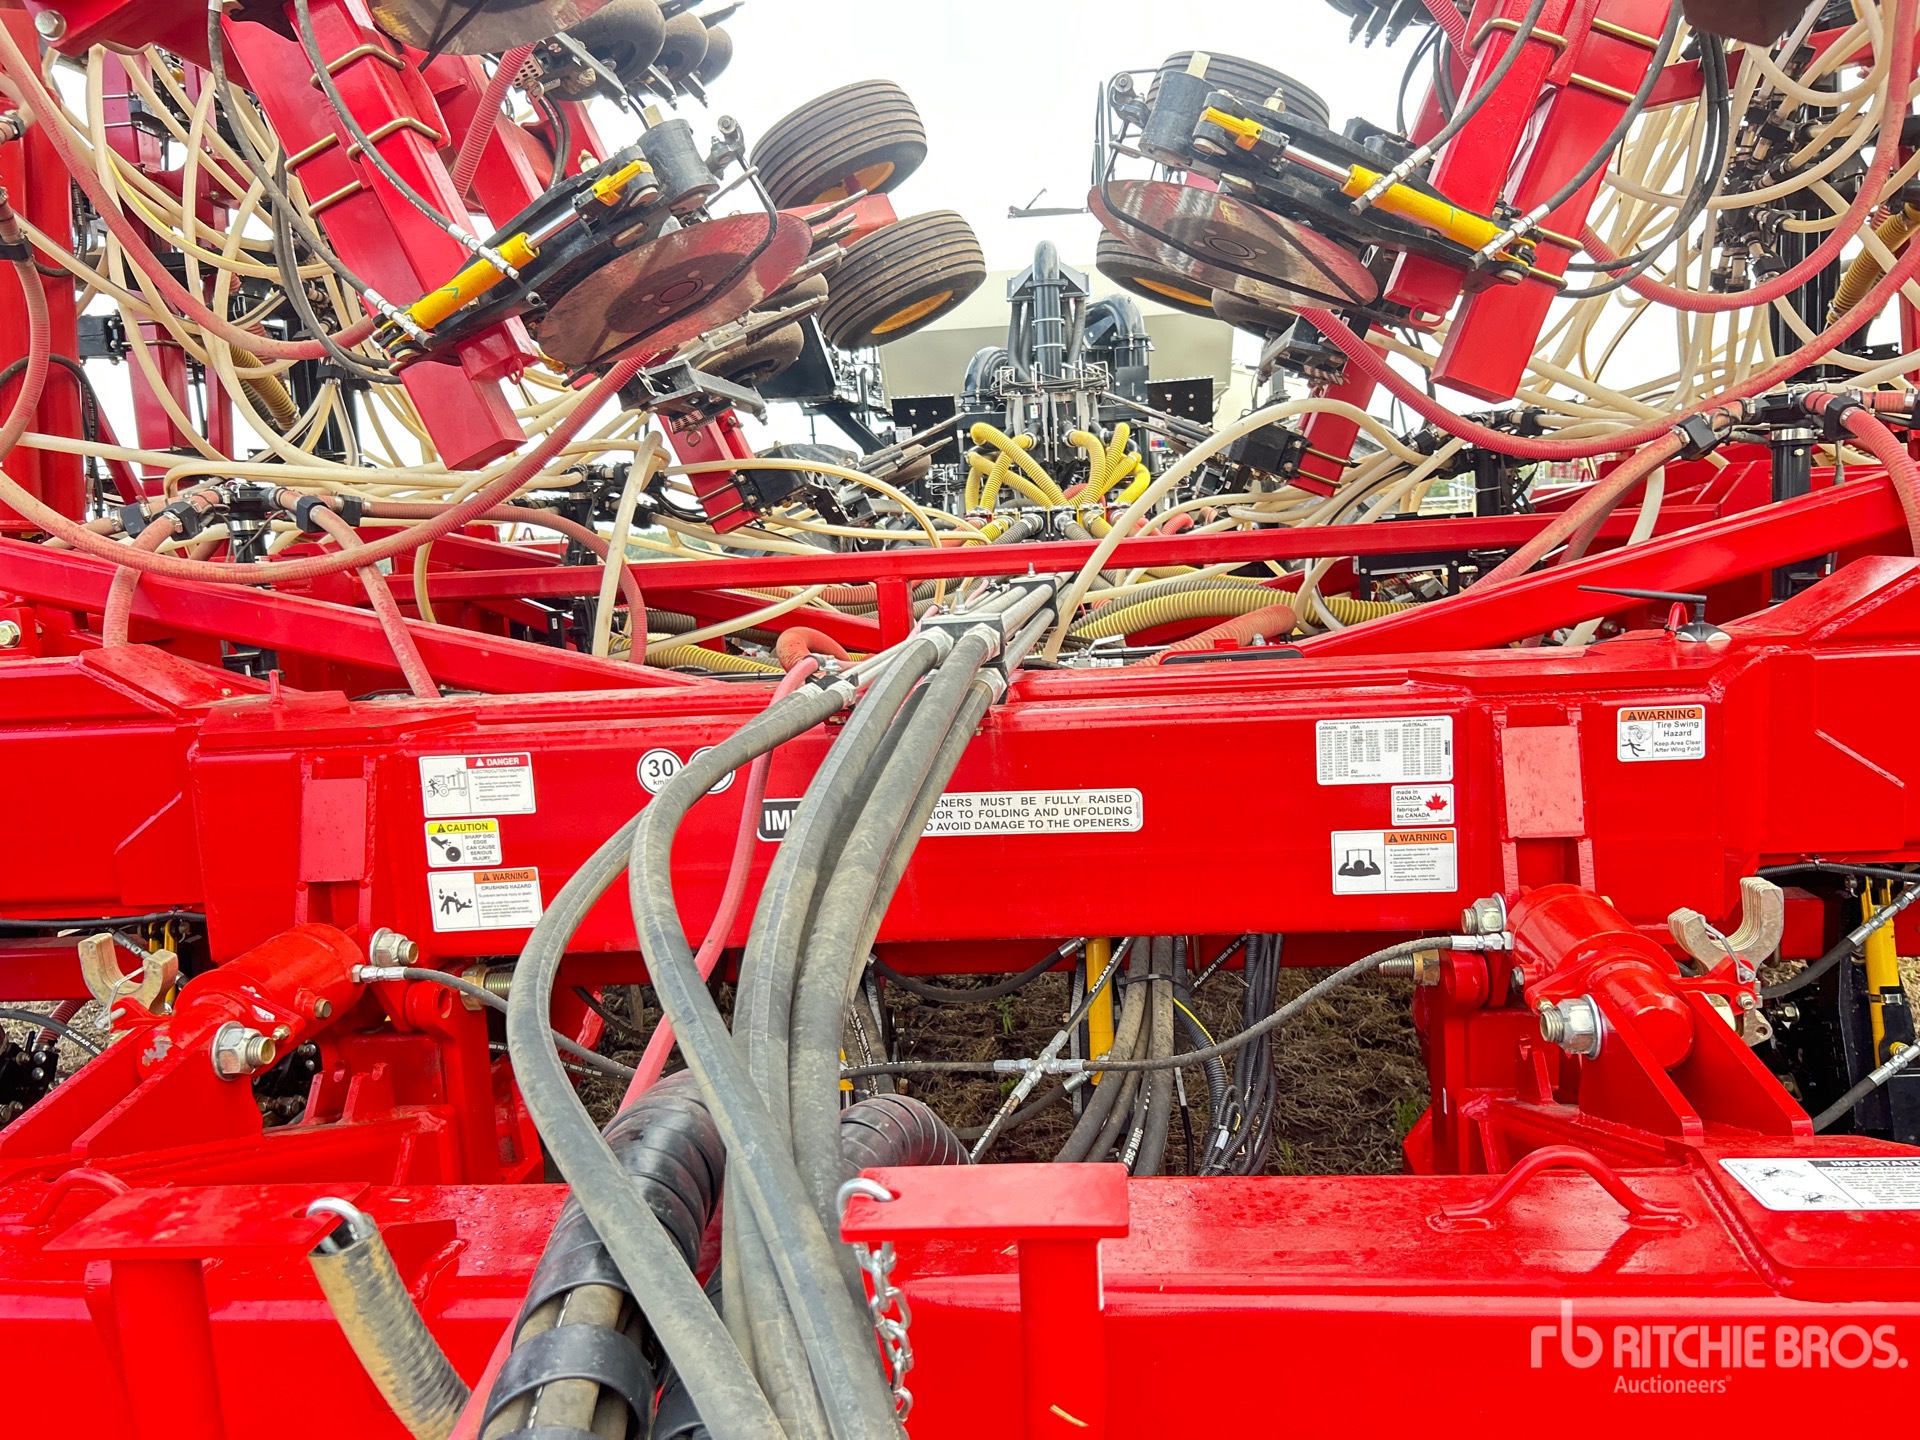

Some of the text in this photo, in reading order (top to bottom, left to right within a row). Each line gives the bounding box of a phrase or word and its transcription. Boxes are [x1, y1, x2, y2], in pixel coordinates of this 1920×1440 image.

[1637, 709, 1696, 720] WARNING
[1674, 720, 1700, 729] Swing
[486, 756, 520, 767] DANGER
[648, 758, 674, 778] 30
[980, 796, 1013, 806] MUST
[1020, 796, 1036, 806] BE
[1044, 795, 1081, 805] FULLY
[1088, 794, 1132, 804] RAISED
[958, 810, 974, 819] TO
[978, 808, 1030, 818] FOLDING
[1034, 808, 1059, 817] AND
[1064, 806, 1133, 816] UNFOLDING
[446, 822, 489, 832] CAUTION
[936, 822, 971, 831] AVOID
[974, 820, 1025, 830] DAMAGE
[1028, 819, 1044, 828] TO
[1047, 818, 1070, 828] THE
[1073, 818, 1133, 828] OPENERS.
[1400, 832, 1448, 842] WARNING
[492, 871, 530, 881] WARNING
[1091, 964, 1112, 993] PULSAR
[1194, 963, 1217, 988] PULSAR
[66, 1029, 91, 1047] PULSAR
[1124, 1127, 1144, 1166] 2SC HARC
